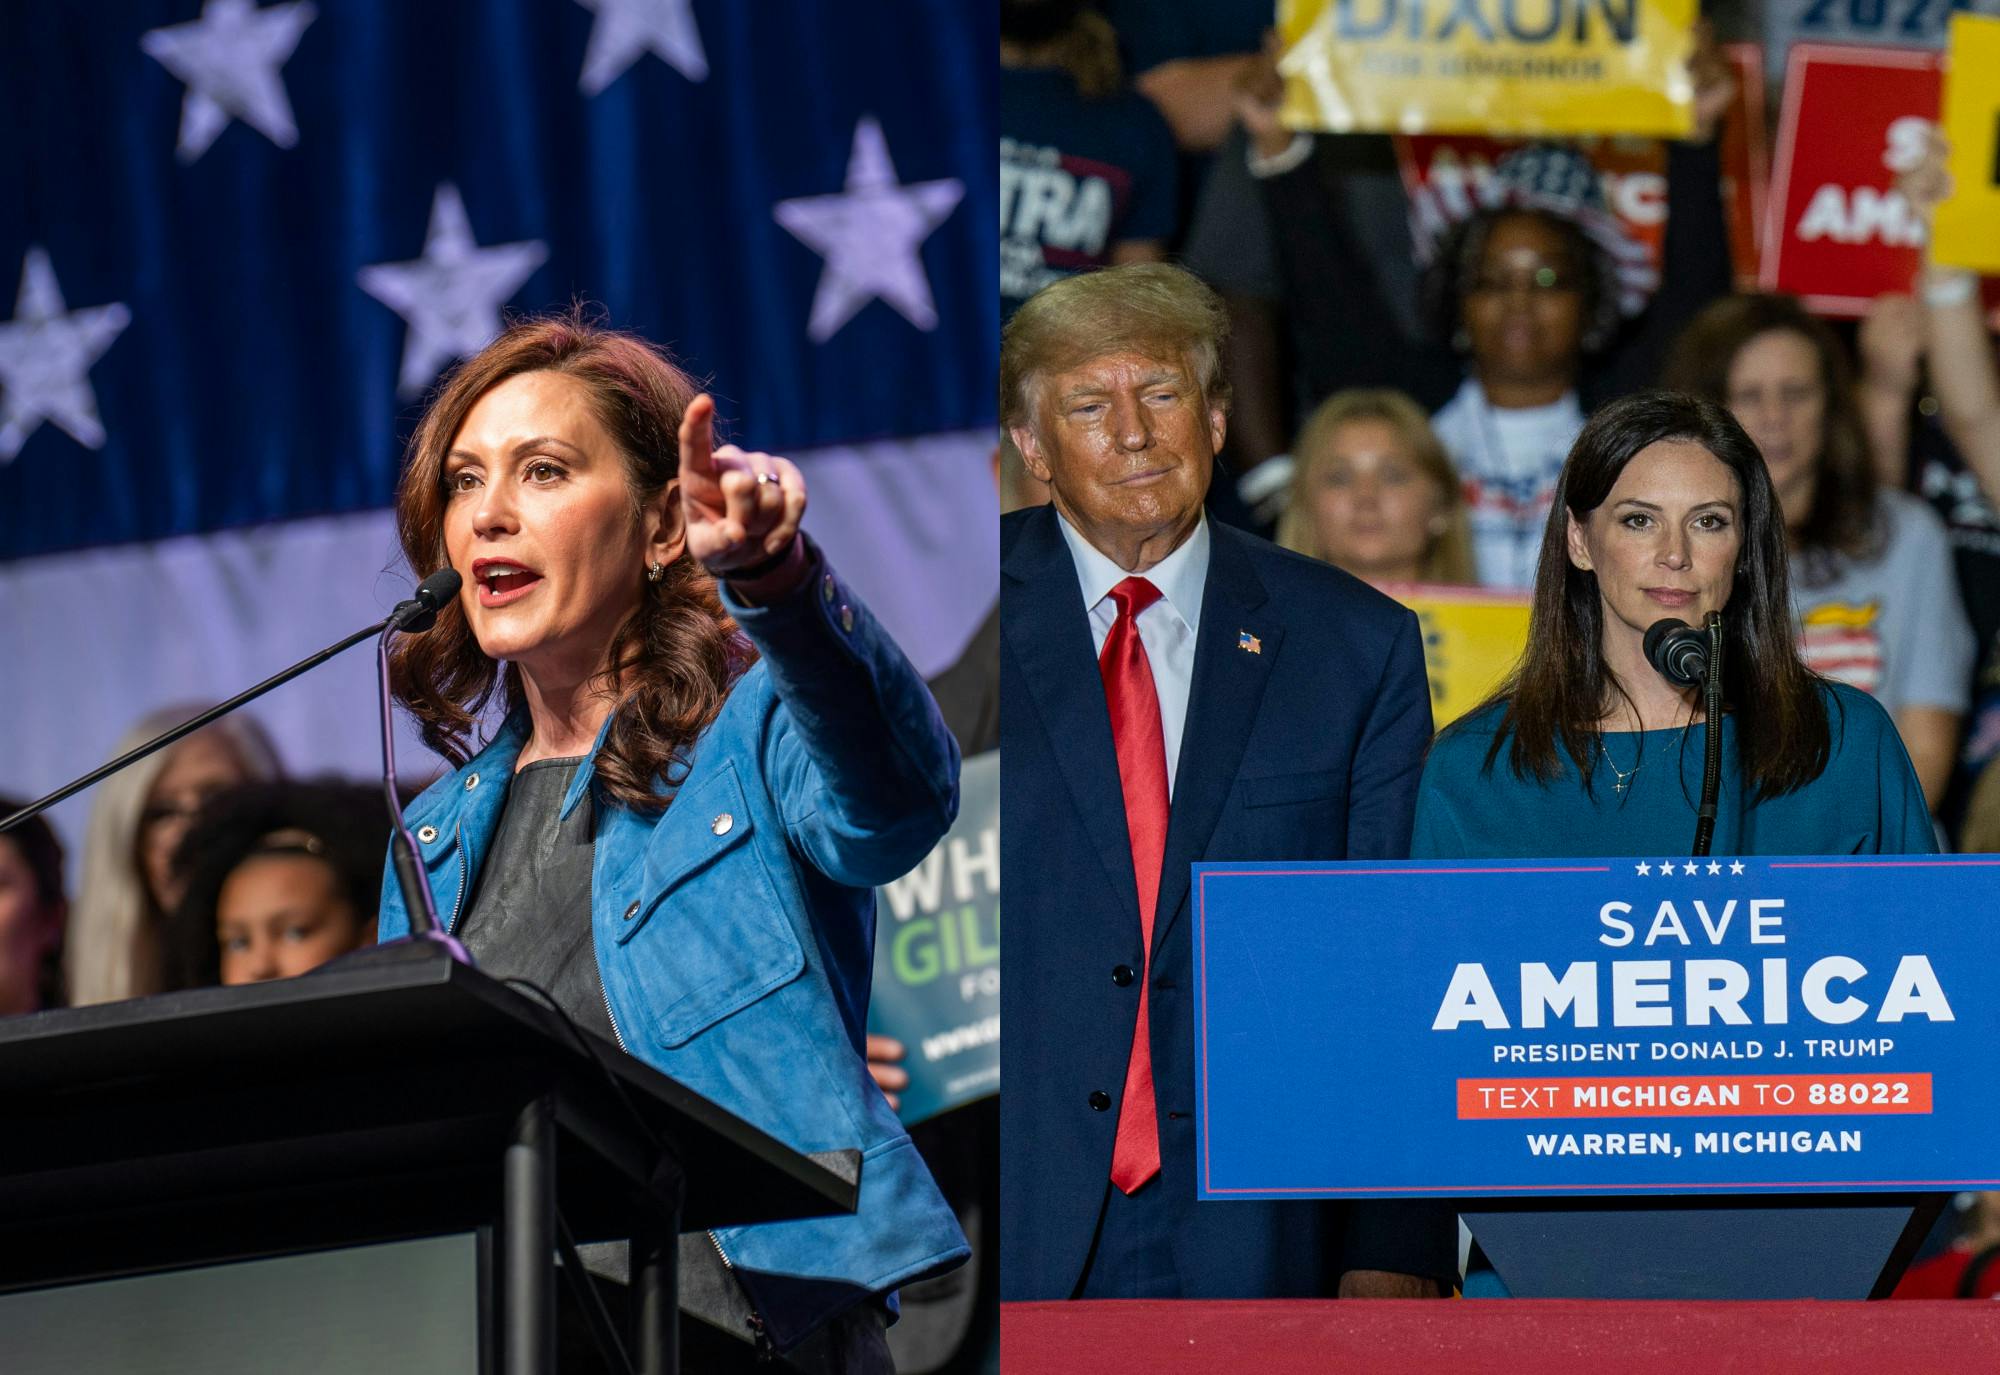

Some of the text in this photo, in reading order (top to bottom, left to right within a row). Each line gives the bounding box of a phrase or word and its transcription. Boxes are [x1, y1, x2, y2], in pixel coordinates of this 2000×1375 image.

[1599, 898, 1786, 947] SAVE
[892, 904, 1000, 986] GIL
[1431, 954, 1956, 1030] AMERICA
[1493, 1038, 1895, 1063] PRESIDENT DONALD J. TRUMP
[1478, 1082, 1909, 1109] TEXT MICHIGAN TO 88022
[1526, 1130, 1862, 1158] WARREN, MICHIGAN
